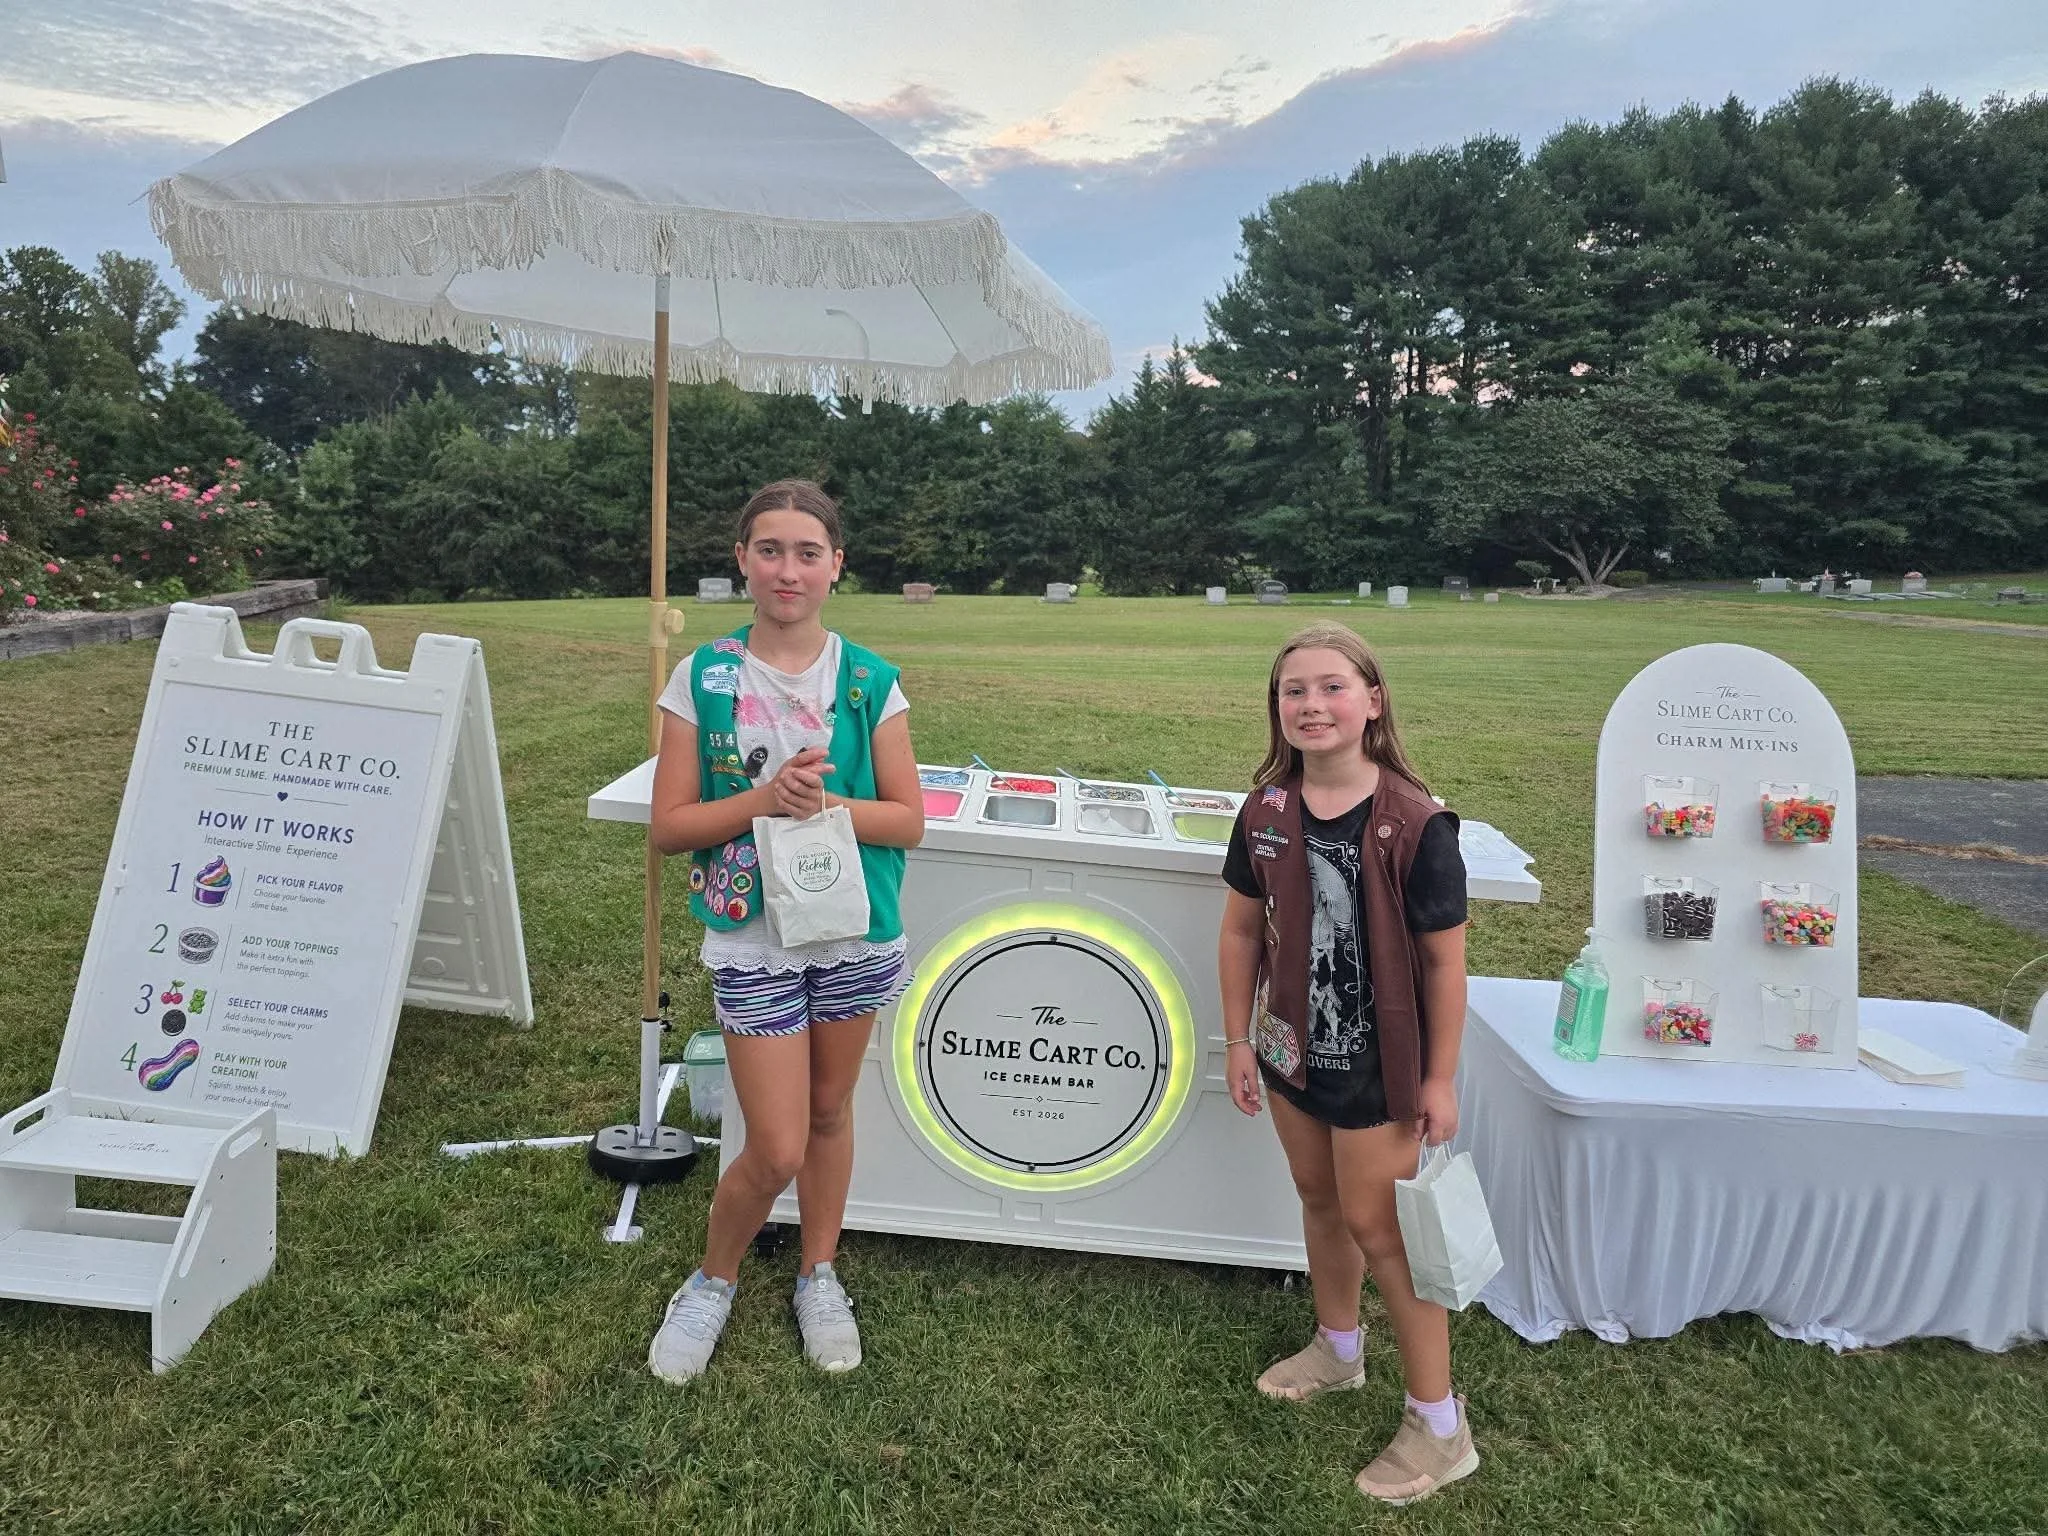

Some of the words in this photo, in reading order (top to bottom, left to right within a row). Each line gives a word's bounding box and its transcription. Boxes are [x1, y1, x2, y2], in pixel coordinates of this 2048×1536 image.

[1716, 686, 1740, 699] The
[268, 721, 315, 741] THE
[184, 735, 270, 763] SLIME
[280, 747, 351, 773] CART
[359, 757, 401, 780] CO.
[183, 761, 232, 776] PREMIUM
[234, 768, 268, 781] SLIME.
[272, 773, 331, 788] HANDMADE
[334, 780, 360, 792] WITH
[362, 784, 393, 796] CARE.
[197, 810, 248, 831] HOW
[255, 817, 275, 834] IT
[283, 820, 355, 844] WORKS
[204, 834, 254, 850] Interactive
[256, 840, 282, 854] Slime
[286, 844, 338, 861] Experience
[798, 855, 832, 875] Kickoff
[165, 862, 181, 893] 1
[256, 874, 278, 885] PICK
[281, 877, 306, 889] YOUR
[307, 880, 344, 894] FLAVOR
[253, 888, 281, 899] Choose
[281, 893, 300, 905] your
[299, 894, 326, 905] favorite
[250, 902, 270, 911] slime
[270, 904, 289, 913] base.
[147, 923, 169, 954] 2
[242, 935, 262, 946] ADD
[265, 938, 291, 950] YOUR
[293, 942, 340, 956] TOPPINGS
[239, 949, 260, 959] Make
[261, 952, 267, 960] it
[267, 953, 285, 962] extra
[286, 954, 299, 964] fun
[299, 956, 314, 966] with
[249, 963, 276, 975] perfect
[134, 983, 154, 1015] 3
[227, 997, 262, 1011] SELECT
[264, 1002, 290, 1015] YOUR
[290, 1005, 329, 1019] CHARMS
[224, 1011, 240, 1022] Add
[241, 1014, 266, 1025] charms
[267, 1018, 276, 1026] to
[276, 1019, 297, 1029] make
[297, 1022, 314, 1031] your
[1031, 1005, 1067, 1026] The
[221, 1024, 241, 1034] slime
[241, 1027, 272, 1040] uniquely
[272, 1030, 294, 1041] yours.
[120, 1041, 138, 1072] 4
[214, 1052, 237, 1063] PLAY
[239, 1055, 261, 1067] WITH
[264, 1058, 288, 1070] YOUR
[211, 1065, 259, 1080] CREATION!
[984, 1070, 1007, 1082] ICE
[1013, 1073, 1062, 1087] CREAM
[1068, 1077, 1095, 1089] BAR
[204, 1094, 221, 1102] your
[234, 1083, 259, 1094] stretch
[260, 1086, 266, 1095] &
[267, 1089, 288, 1099] enjoy
[1012, 1109, 1033, 1118] EST
[1037, 1110, 1065, 1120] 2026
